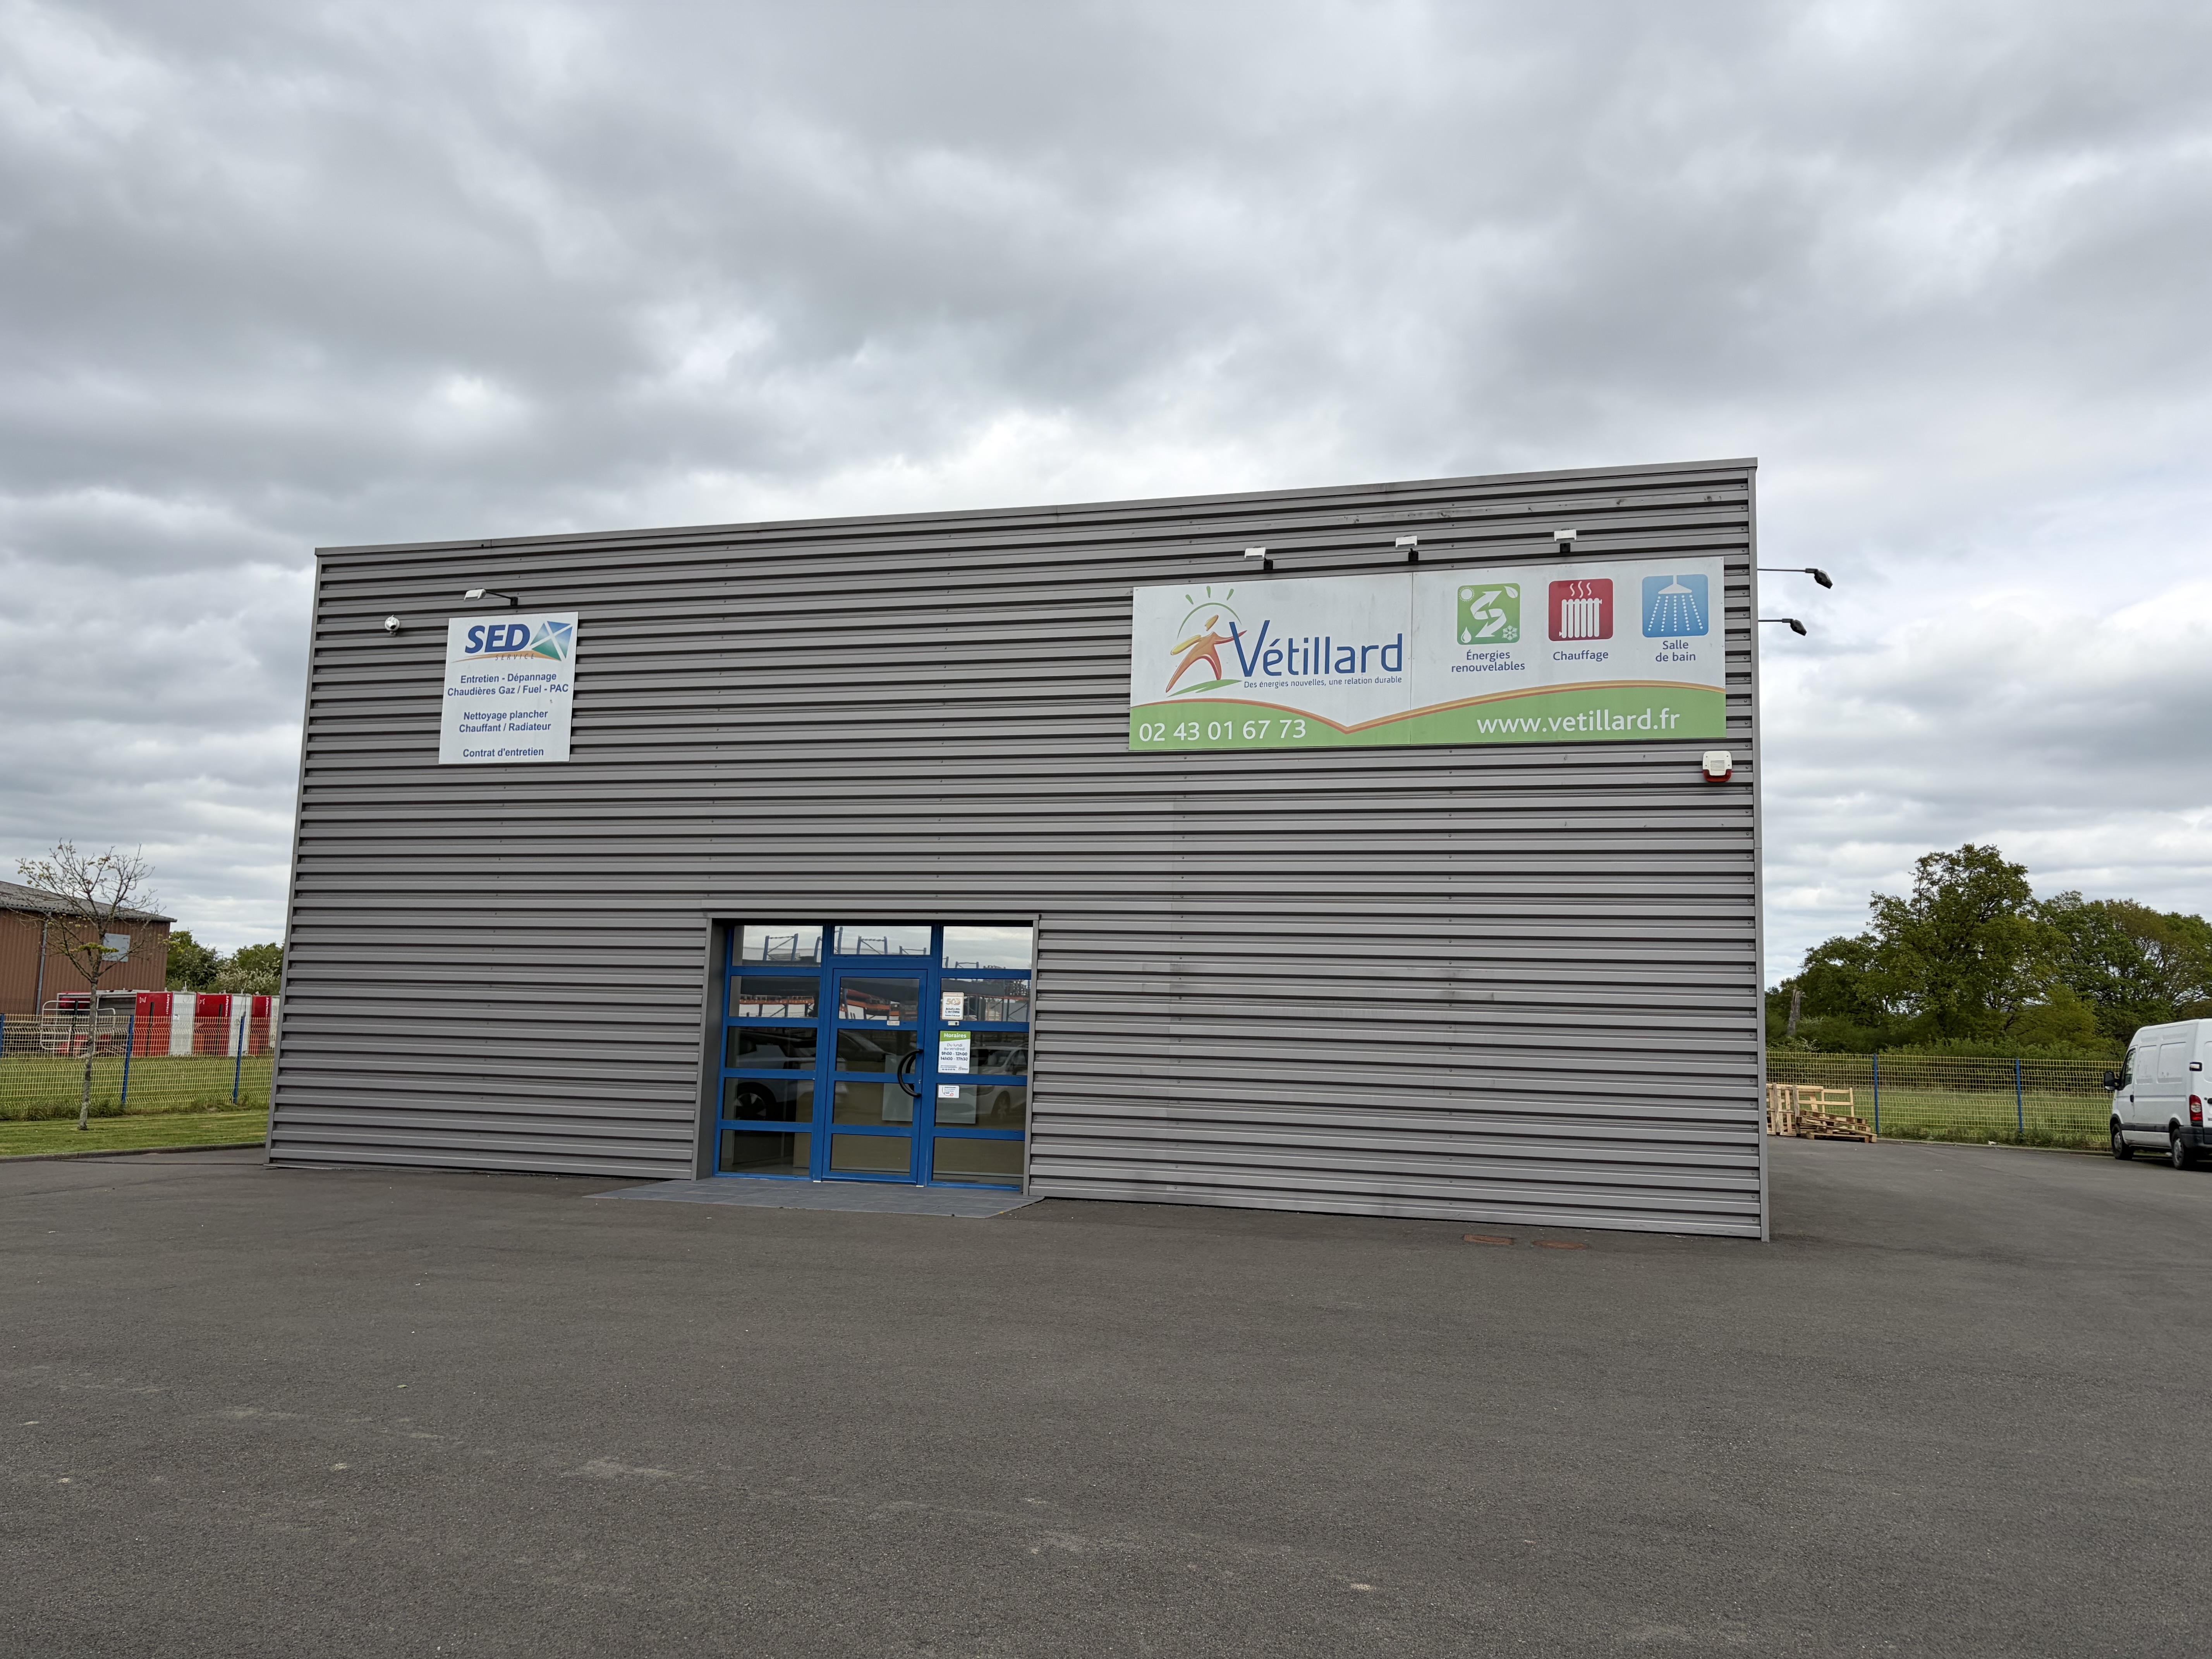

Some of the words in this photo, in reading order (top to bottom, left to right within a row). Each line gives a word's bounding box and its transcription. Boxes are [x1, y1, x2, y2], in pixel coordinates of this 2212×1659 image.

[465, 623, 531, 654] SED
[1662, 639, 1689, 650] Salle
[1229, 620, 1403, 677] Vétillard
[1467, 649, 1510, 662] Énergies
[1553, 649, 1609, 662] Chauffage
[1656, 652, 1669, 662] de
[1673, 651, 1696, 661] bain
[1451, 661, 1525, 672] renouvelables
[460, 674, 499, 684] Entretien
[507, 673, 557, 684] Dépannage
[1259, 680, 1289, 689] énergies
[1291, 678, 1327, 687] nouvelles,
[448, 687, 496, 696] Chaudières
[498, 686, 515, 694] Gaz
[517, 685, 521, 694] /
[523, 684, 541, 694] Fuel
[550, 684, 568, 692] PAC
[464, 712, 507, 721] Nettoyage
[510, 709, 548, 721] plancher
[1477, 708, 1680, 733] www.vetillard.fr
[459, 723, 501, 733] Chauffant
[503, 723, 507, 732] /
[508, 722, 551, 731] Radiateur
[1139, 723, 1165, 742] 02
[1173, 722, 1200, 740] 43
[1208, 721, 1232, 740] 01
[1243, 720, 1271, 739] 67
[1279, 719, 1306, 738] 73
[463, 749, 495, 757] Contrat
[497, 747, 544, 756] d'entretien
